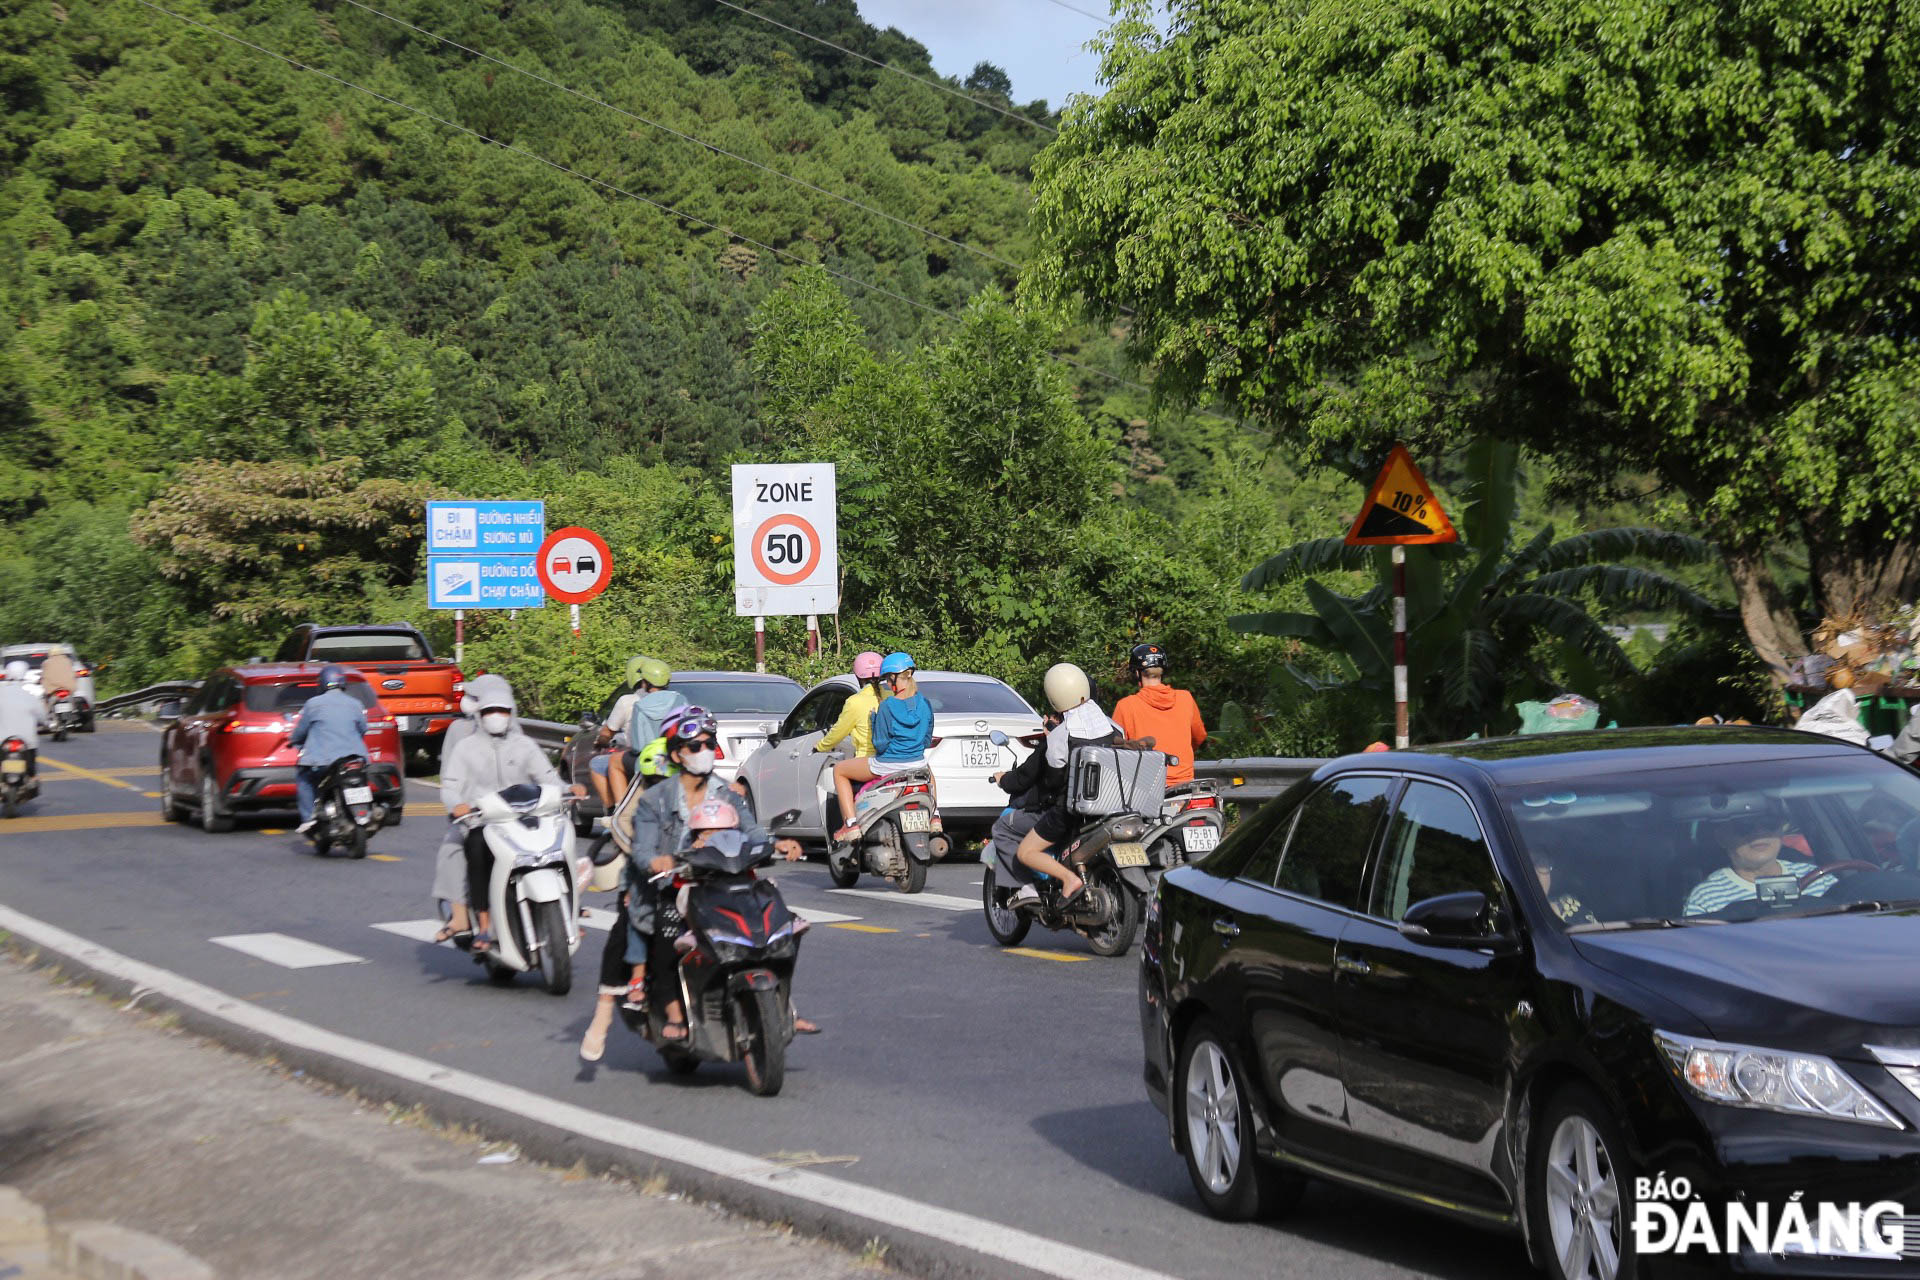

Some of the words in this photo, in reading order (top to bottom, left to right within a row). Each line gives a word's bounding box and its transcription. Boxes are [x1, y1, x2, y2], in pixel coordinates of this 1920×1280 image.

[756, 483, 813, 502] ZONE
[1392, 491, 1427, 519] 10%
[767, 534, 803, 564] 50
[520, 560, 538, 578] DỐ
[971, 741, 990, 753] 75A
[965, 753, 997, 766] 162.57
